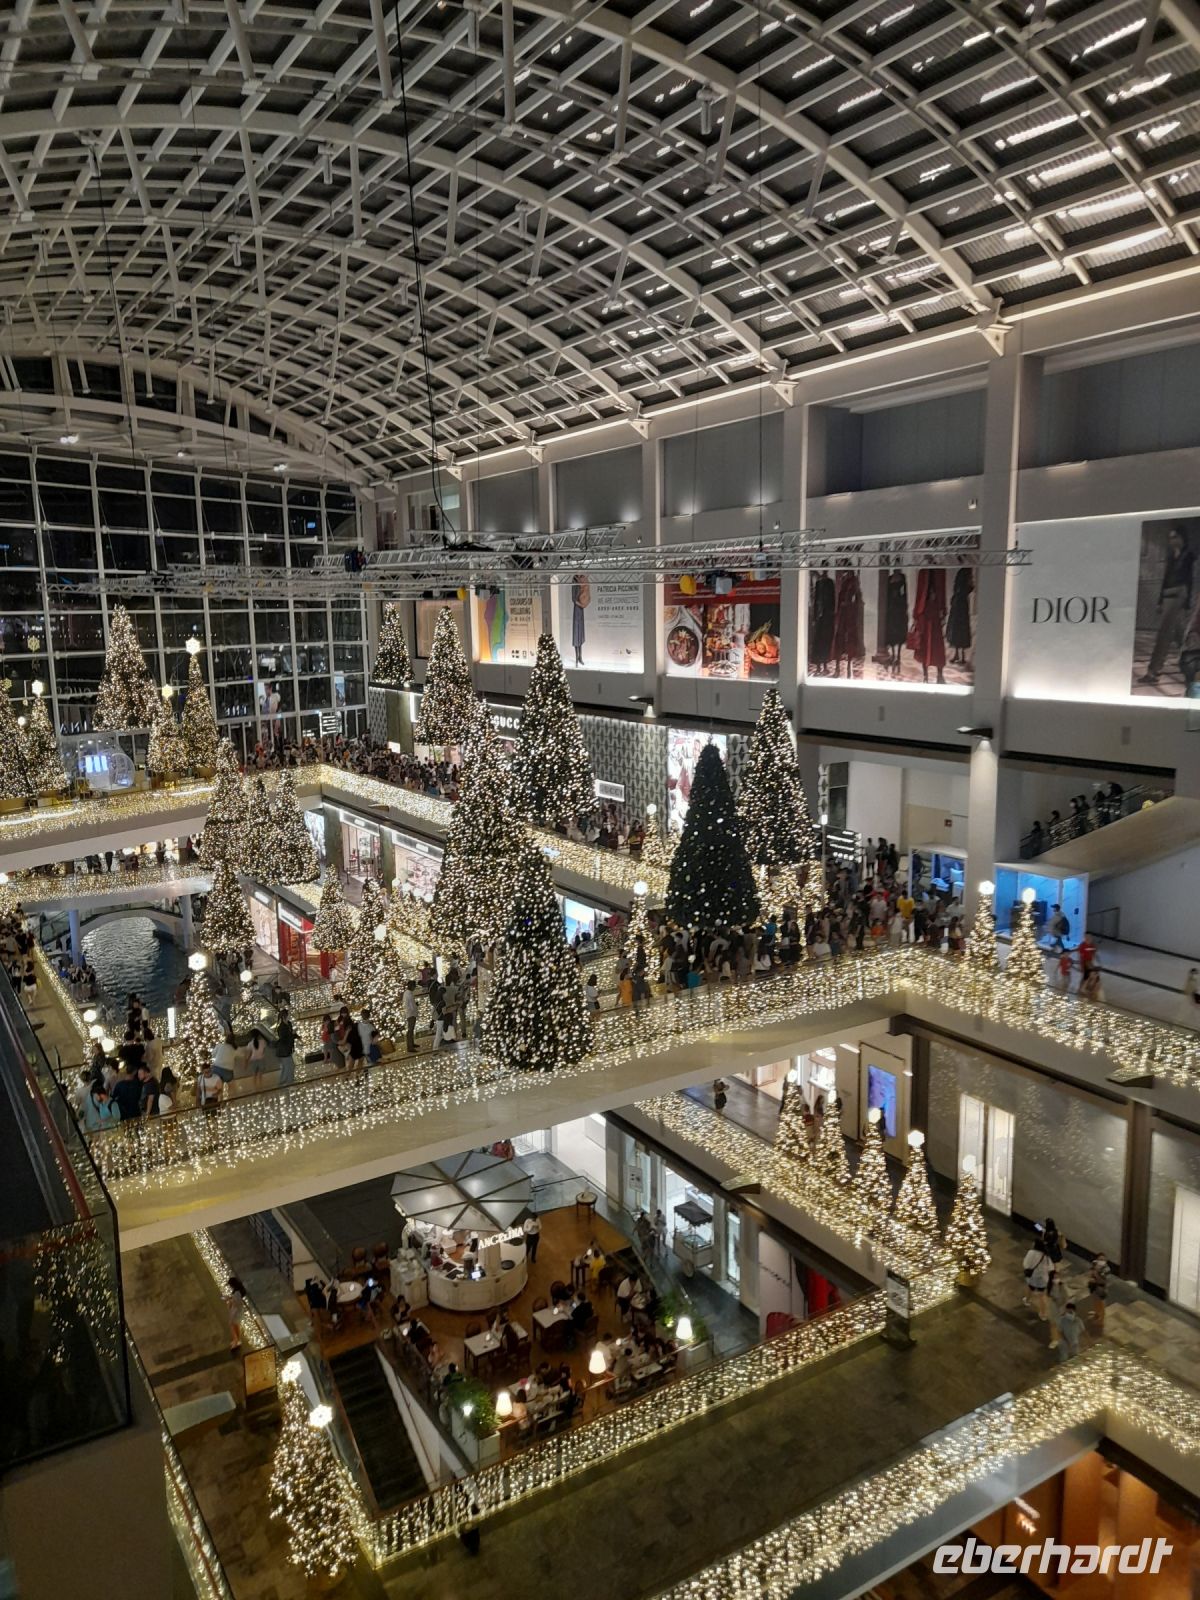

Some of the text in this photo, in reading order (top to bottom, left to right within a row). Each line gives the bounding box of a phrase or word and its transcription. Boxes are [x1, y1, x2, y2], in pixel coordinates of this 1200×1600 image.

[597, 585, 617, 593] PATRICIA
[1031, 596, 1111, 623] DIOR
[493, 715, 520, 730] GUCC
